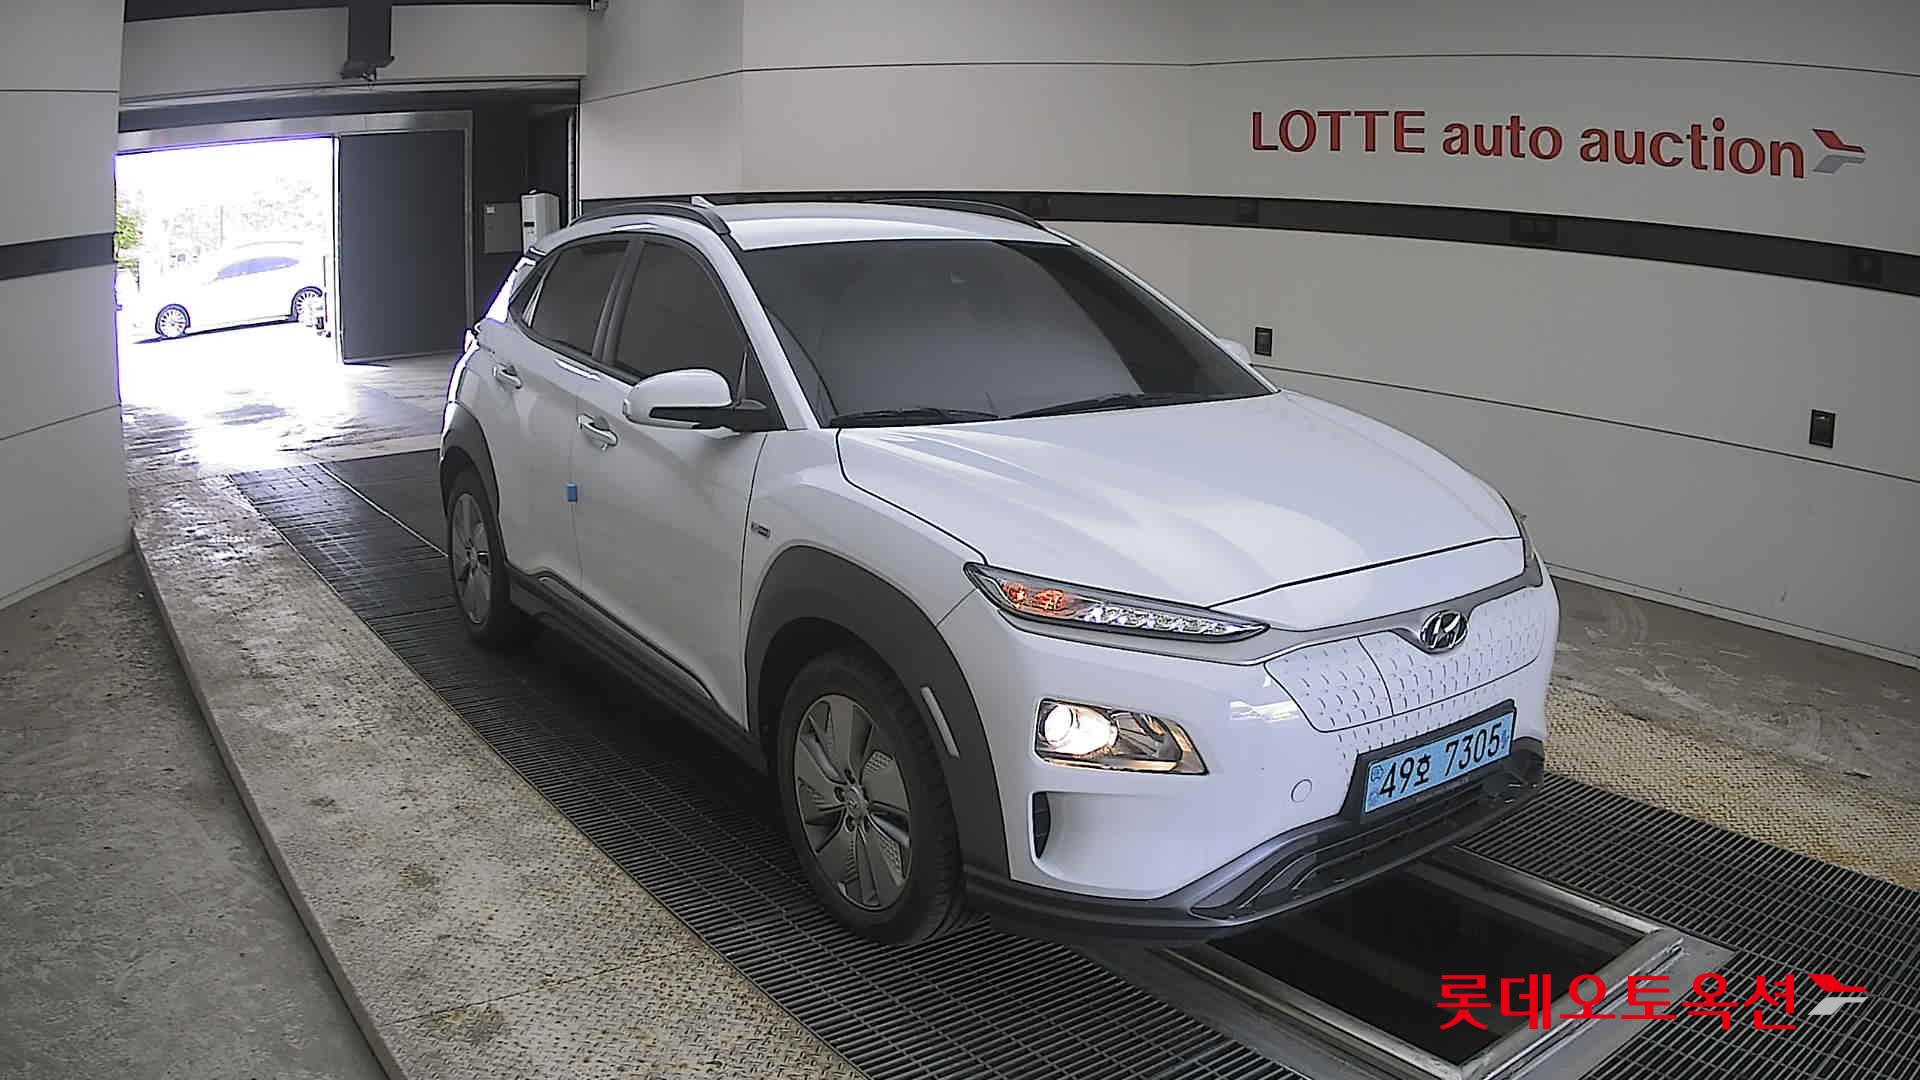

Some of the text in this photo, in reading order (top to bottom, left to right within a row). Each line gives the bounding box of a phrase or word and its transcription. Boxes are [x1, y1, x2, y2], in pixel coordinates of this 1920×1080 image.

[1252, 109, 1806, 179] LOTTE auto auction
[1379, 722, 1502, 798] 49호 7305
